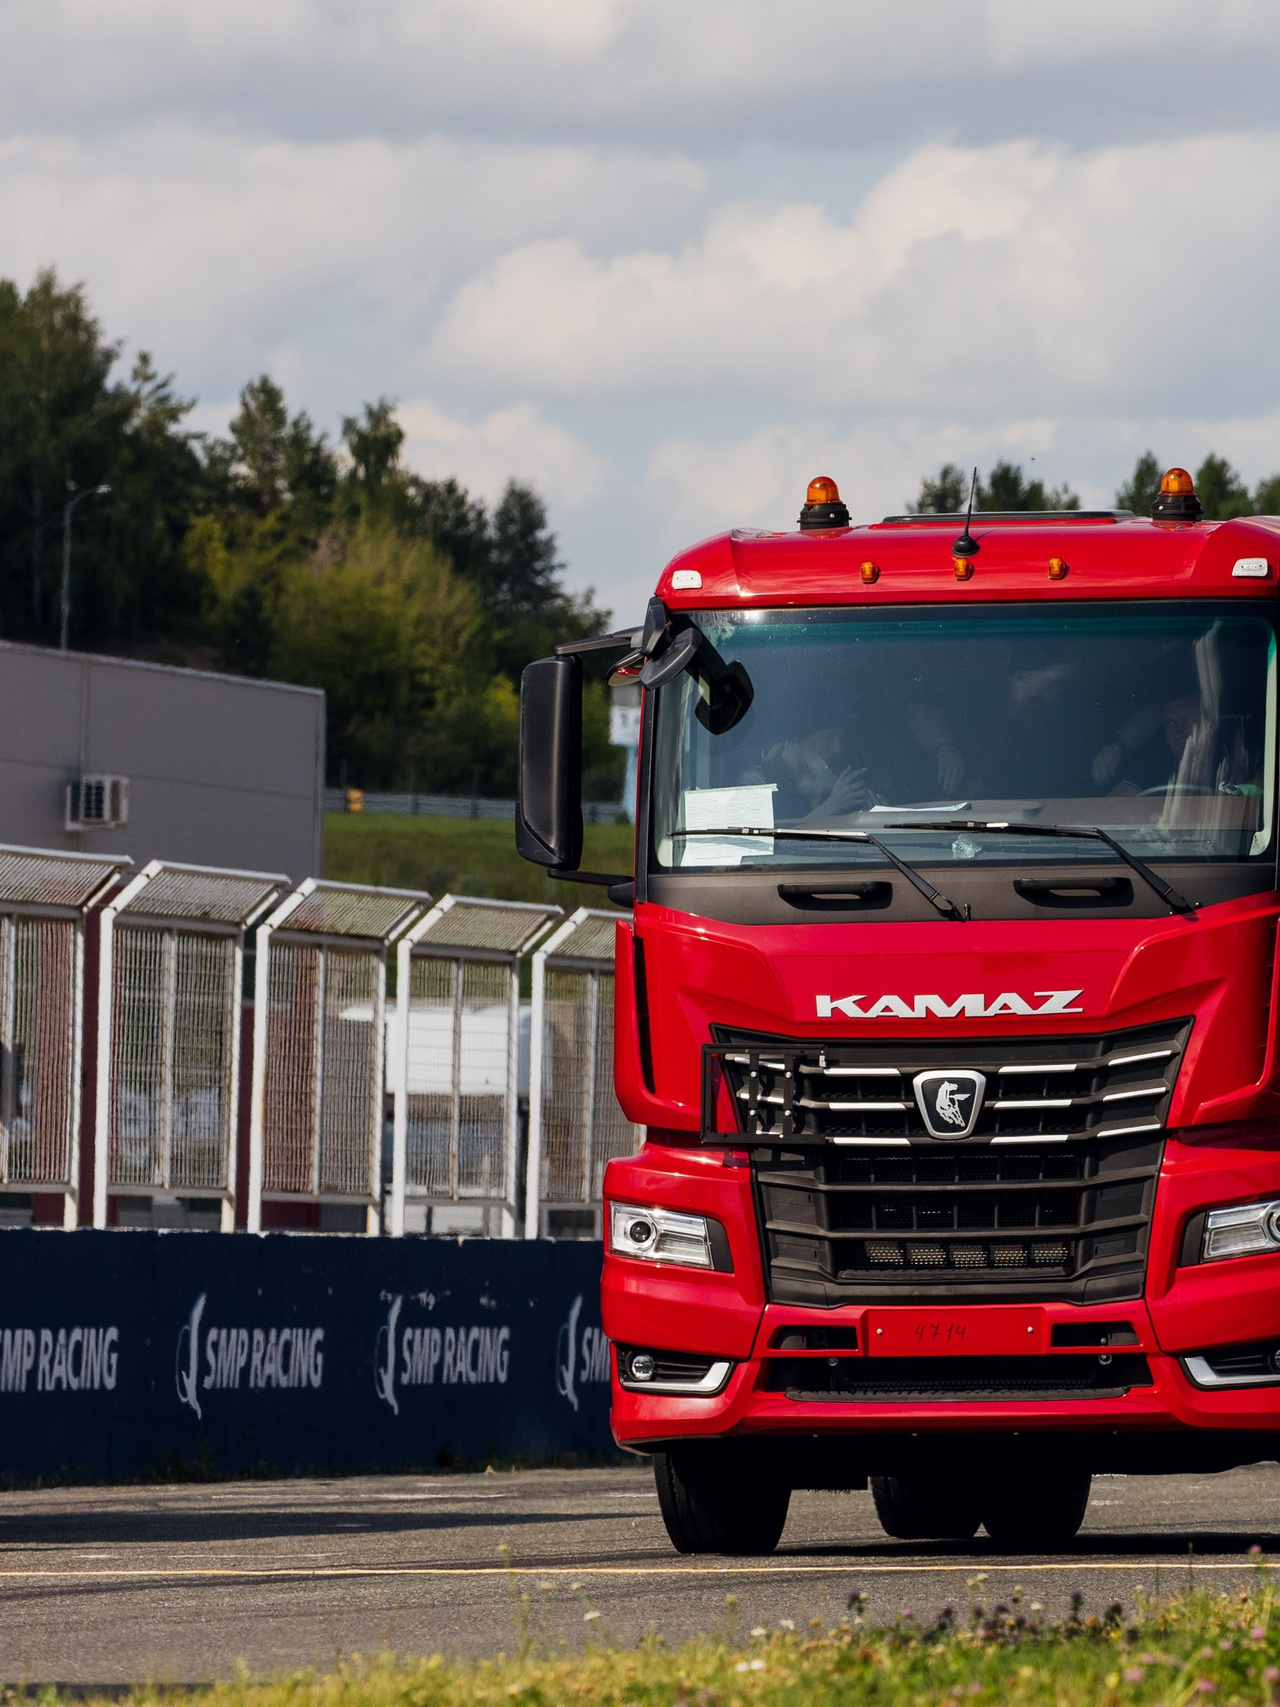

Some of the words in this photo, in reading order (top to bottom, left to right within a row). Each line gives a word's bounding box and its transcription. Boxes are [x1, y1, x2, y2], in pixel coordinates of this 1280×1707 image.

[815, 988, 1084, 1018] KAMAZ
[0, 1328, 36, 1392] MP
[37, 1326, 119, 1392] RACING
[202, 1327, 249, 1390] SMP
[249, 1327, 324, 1388] RACING
[401, 1326, 441, 1385] SMP
[442, 1326, 510, 1384] RACING
[914, 1323, 967, 1343] 4714
